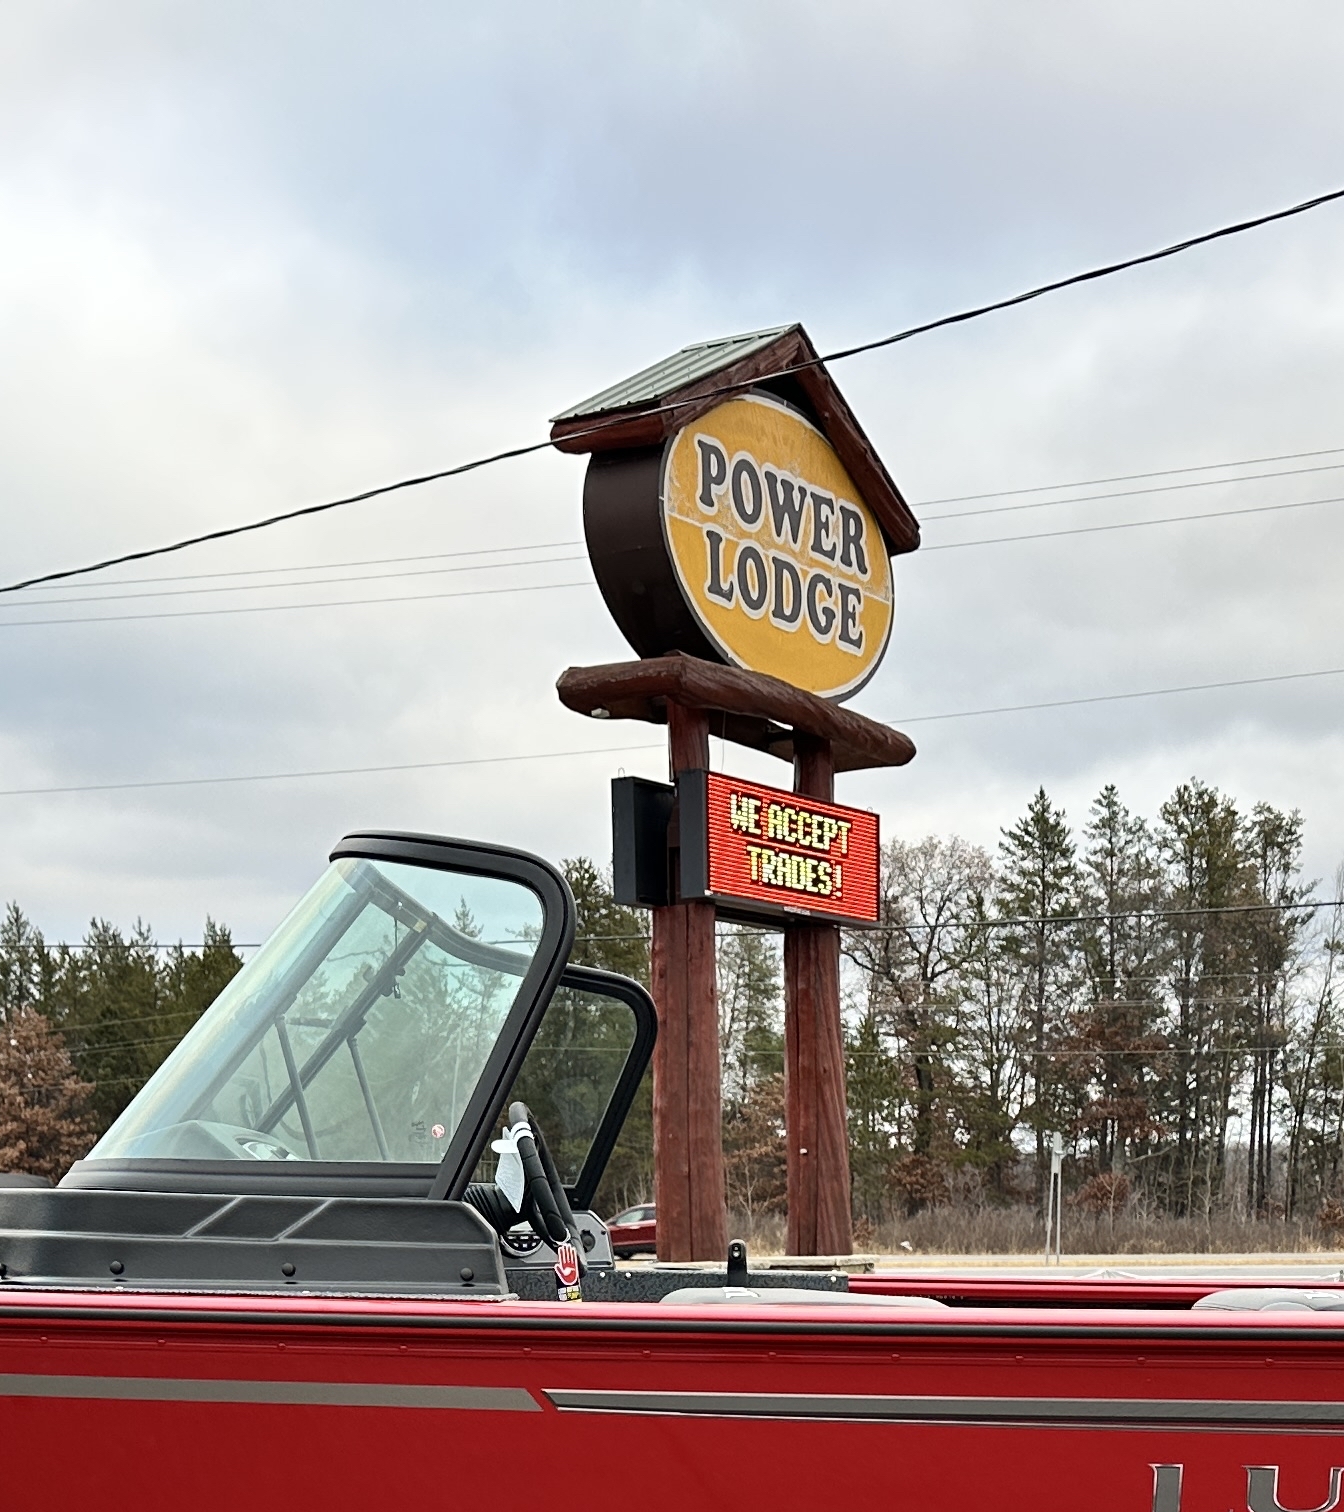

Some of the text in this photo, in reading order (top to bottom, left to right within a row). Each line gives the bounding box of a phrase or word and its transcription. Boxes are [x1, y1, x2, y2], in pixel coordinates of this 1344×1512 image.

[697, 438, 869, 575] POWER
[705, 529, 864, 650] LODGE
[730, 793, 852, 854] WE ACCEPT
[745, 845, 843, 898] TRADES!
